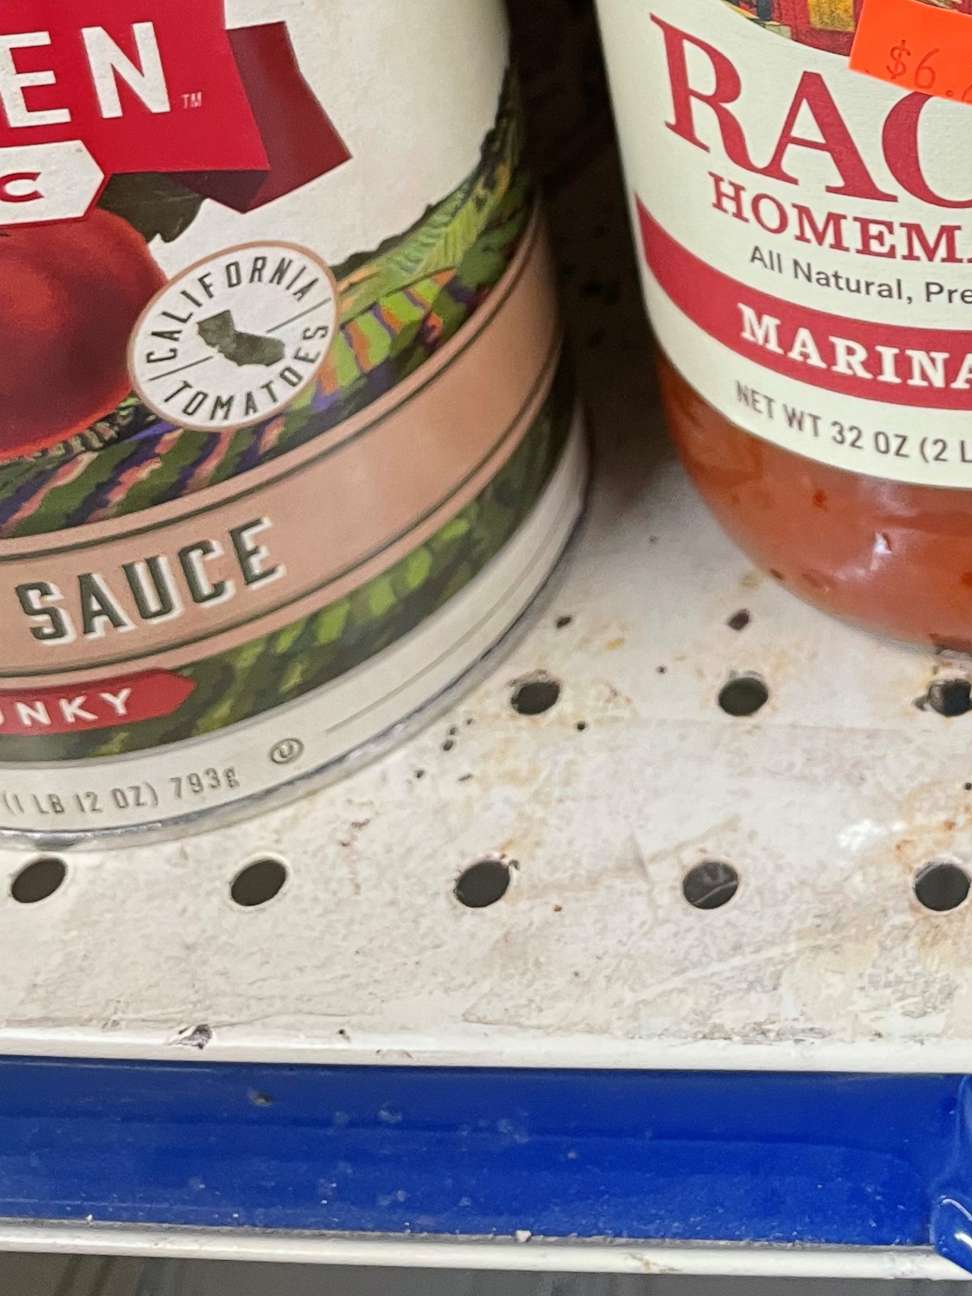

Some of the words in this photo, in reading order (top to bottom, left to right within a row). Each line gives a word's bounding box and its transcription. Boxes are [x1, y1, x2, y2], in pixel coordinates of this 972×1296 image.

[146, 255, 320, 366] CALIFORNIA
[749, 245, 784, 275] All
[792, 261, 914, 304] Natural,
[163, 322, 331, 421] TOMATOES
[735, 381, 775, 419] NET
[783, 405, 822, 438] WT
[831, 421, 864, 450] 32
[873, 431, 909, 458] OZ
[919, 437, 949, 464] (2
[15, 516, 286, 646] SAUCE
[0, 688, 133, 728] NKY
[32, 792, 65, 815] LB
[169, 766, 241, 800] 793g
